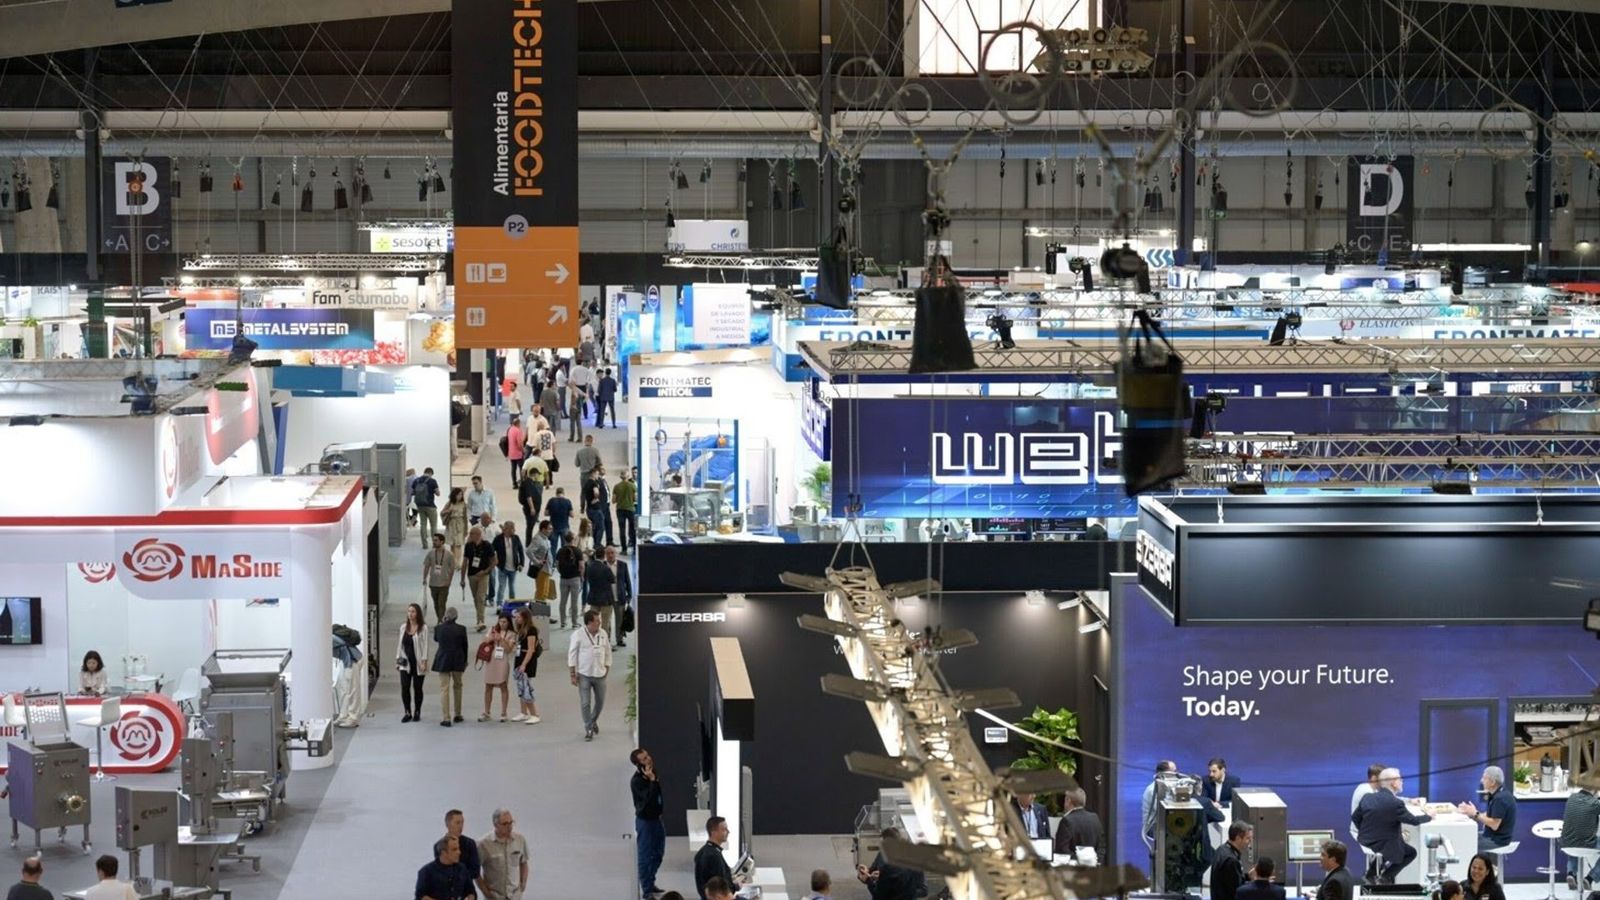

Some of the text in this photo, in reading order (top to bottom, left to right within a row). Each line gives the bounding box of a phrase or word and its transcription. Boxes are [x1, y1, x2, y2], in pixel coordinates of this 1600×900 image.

[513, 0, 543, 195] FOODTECH
[493, 91, 509, 195] Alimentaria
[115, 162, 160, 215] B
[1360, 164, 1404, 216] D
[508, 222, 525, 233] P2
[115, 234, 160, 251] A C
[392, 236, 443, 248] sesotec
[1357, 235, 1402, 251] C E
[313, 291, 409, 304] fam stumabo
[243, 323, 349, 335] METALSYSTEM
[1434, 329, 1600, 339] FRONTMATE
[656, 612, 726, 623] BIZERBA
[1183, 664, 1395, 691] Shape your Future.
[1182, 695, 1261, 721] Today.
